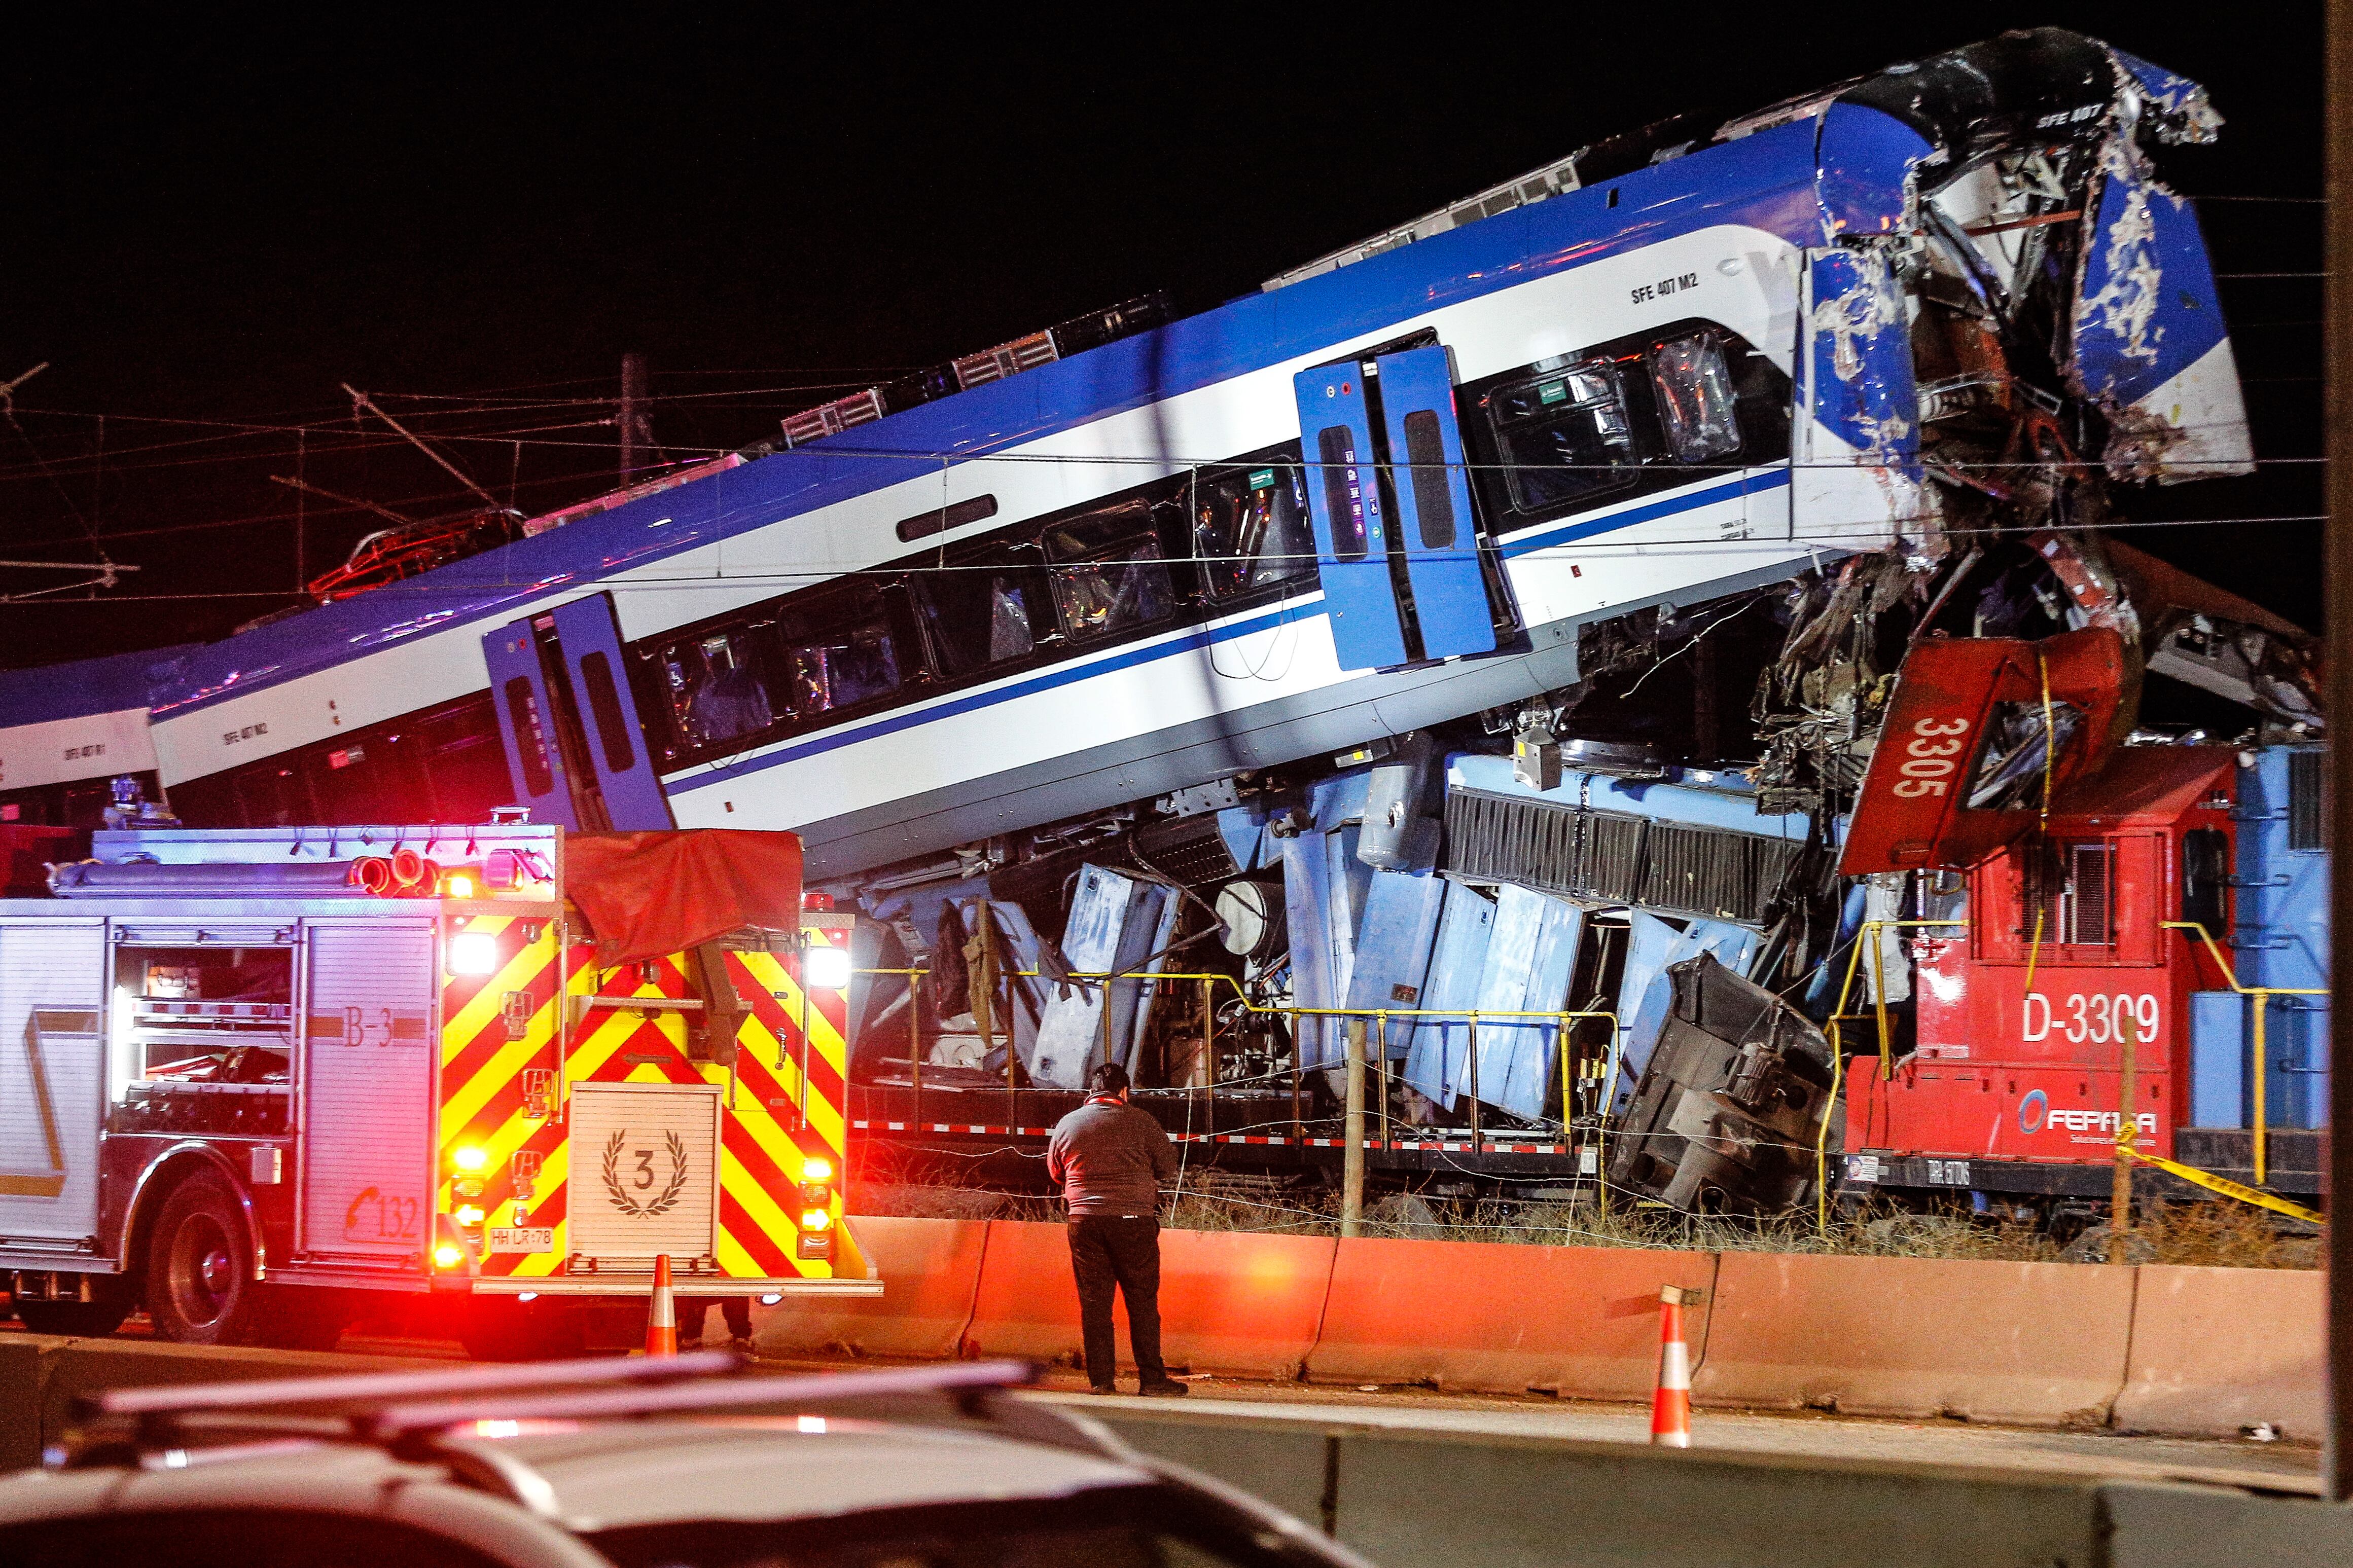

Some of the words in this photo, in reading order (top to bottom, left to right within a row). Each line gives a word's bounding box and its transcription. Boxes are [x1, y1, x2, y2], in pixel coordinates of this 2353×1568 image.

[2036, 112, 2070, 128] SFE
[1631, 285, 1655, 304] SFE
[1657, 278, 1675, 296] 407
[1678, 272, 1699, 290] M2
[1892, 717, 1970, 797] 3305
[345, 1006, 391, 1047] B-3
[2023, 992, 2159, 1043] D-3309
[2047, 1109, 2156, 1134] FEPAA
[634, 1150, 654, 1190] 3
[378, 1196, 417, 1238] 132
